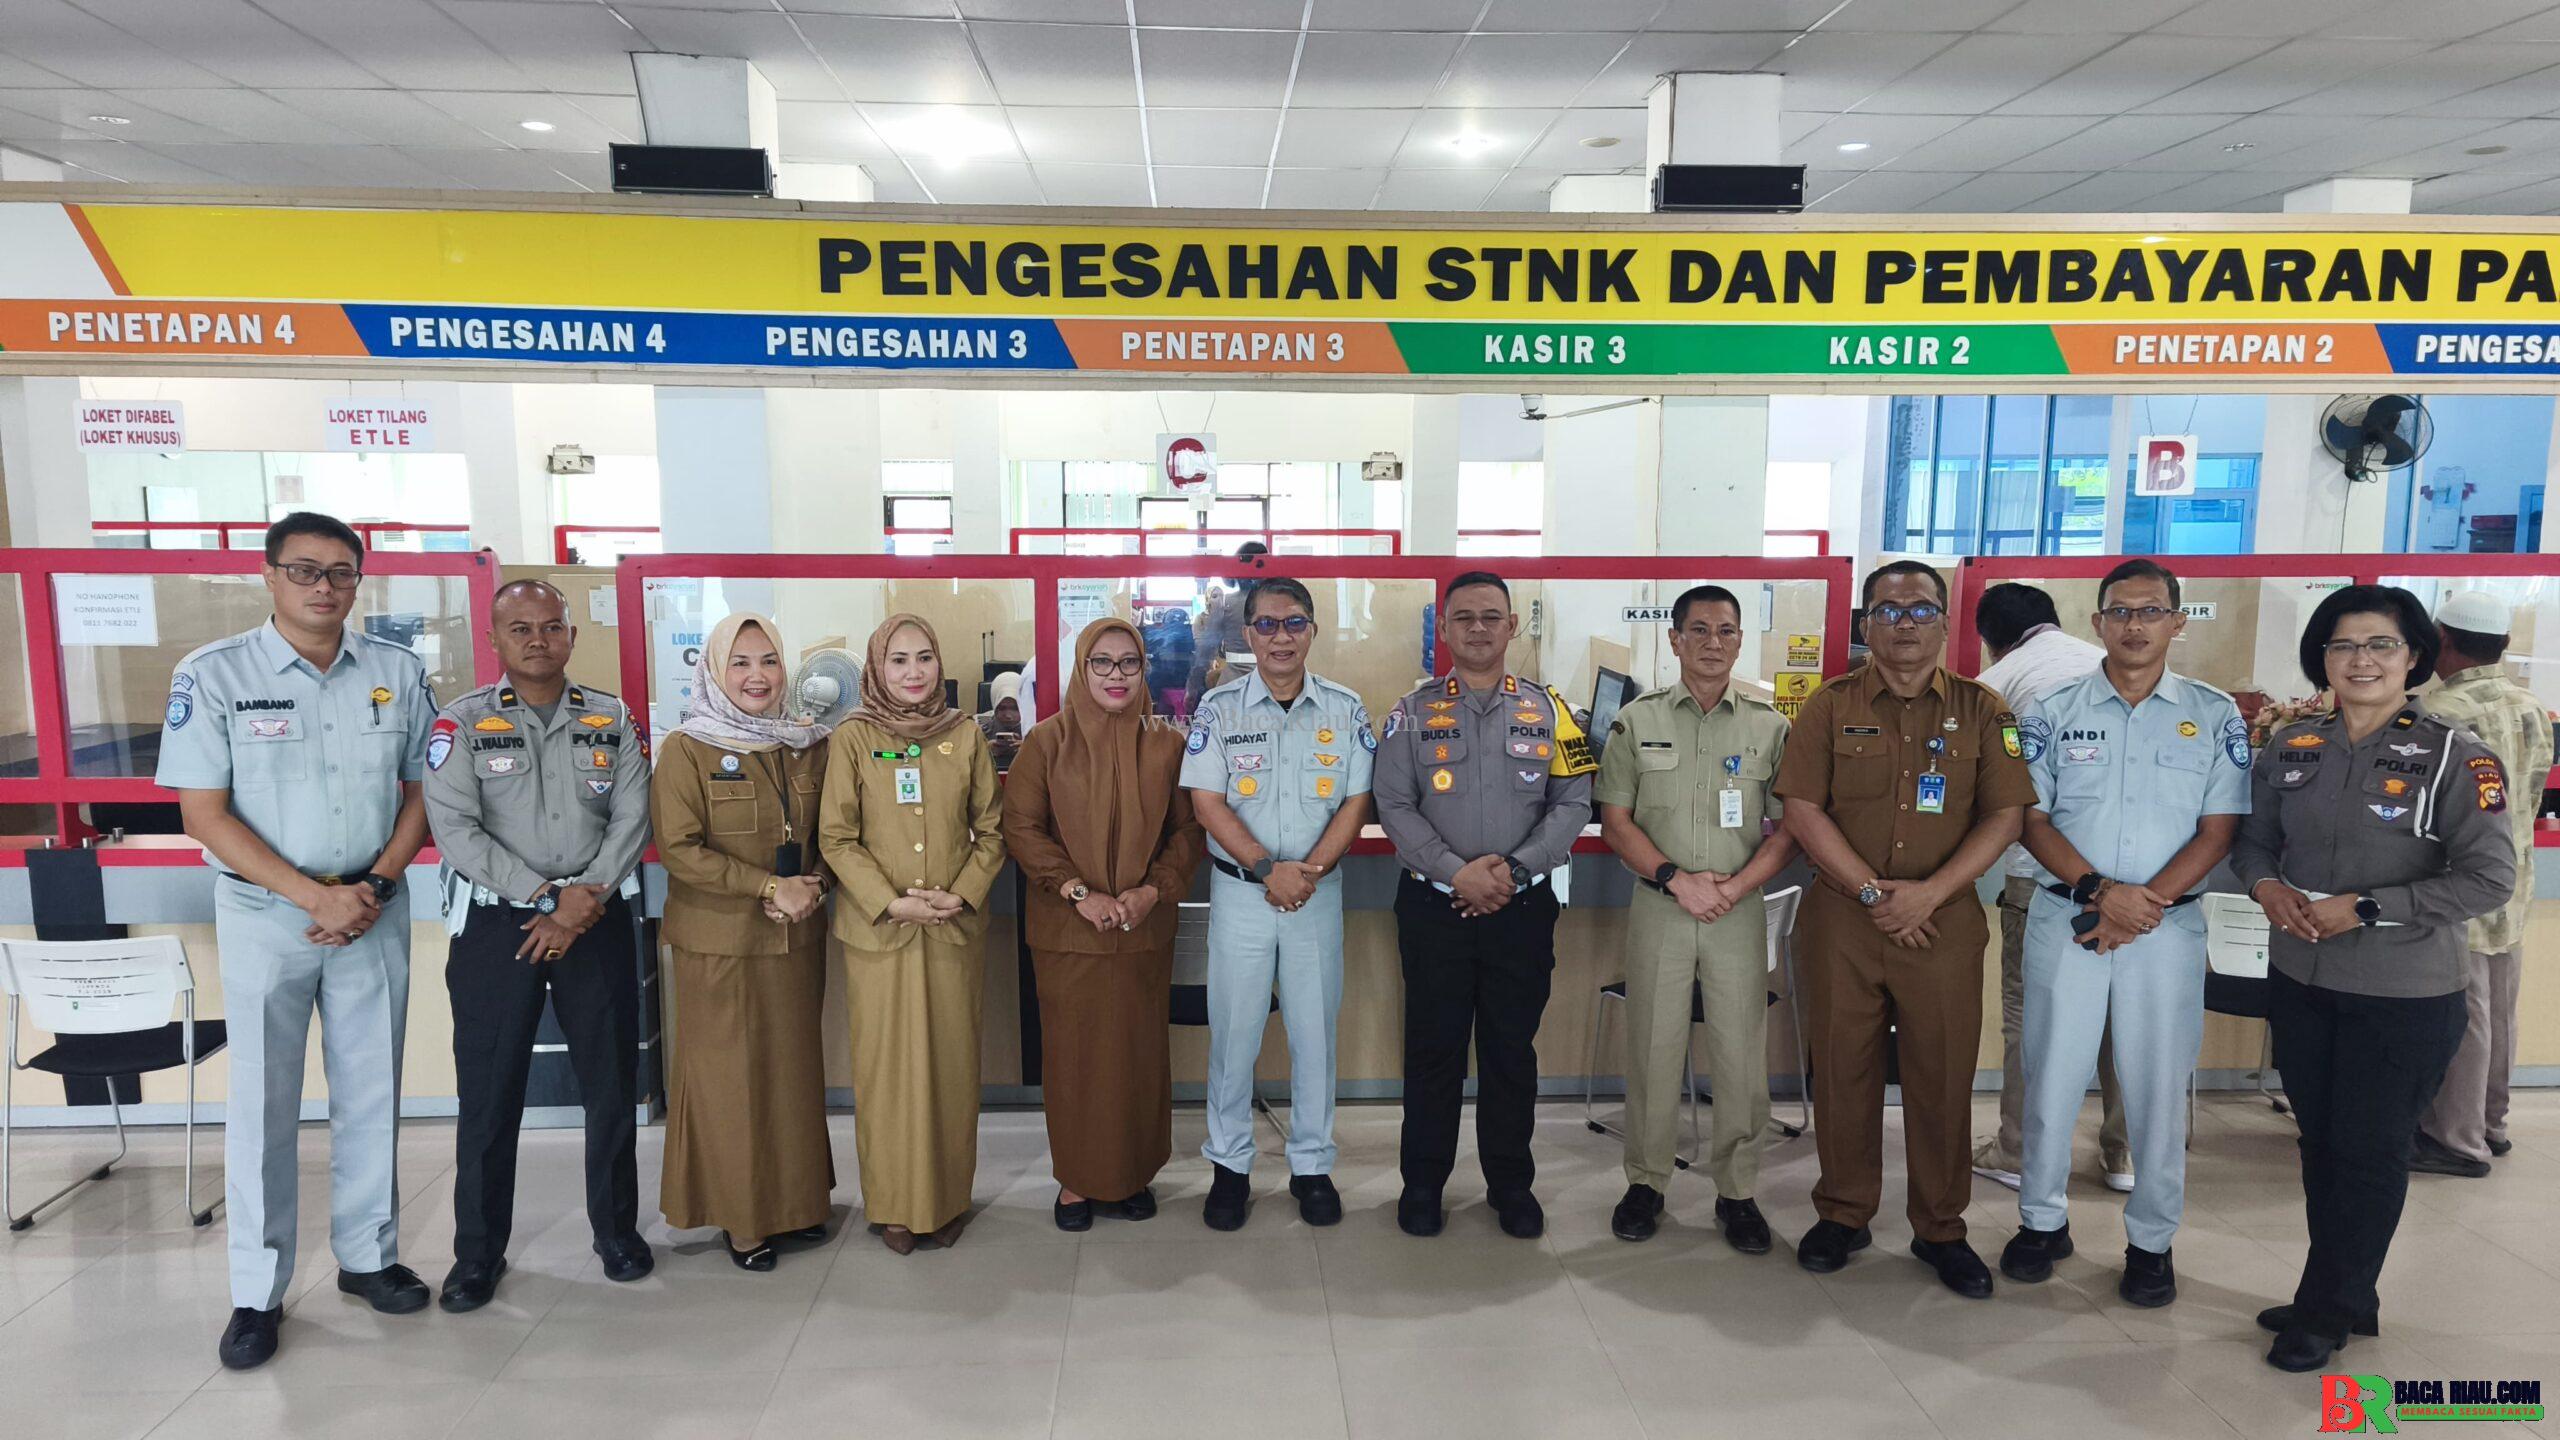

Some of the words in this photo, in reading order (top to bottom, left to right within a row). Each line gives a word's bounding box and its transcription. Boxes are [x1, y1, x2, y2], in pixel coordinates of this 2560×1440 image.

[819, 238, 1397, 301] PENGESAHAN
[1425, 246, 1640, 303] STNK
[1669, 249, 1835, 303] DAN
[1865, 248, 2432, 303] PEMBAYARAN
[2457, 249, 2560, 303] PA
[48, 311, 262, 344] PENETAPAN
[274, 314, 296, 345] 4
[390, 316, 635, 352] PENGESAHAN
[645, 323, 667, 353] 4
[766, 327, 997, 358] PENGESAHAN
[1009, 330, 1028, 359] 3
[1122, 331, 1315, 361] PENETAPAN
[1326, 332, 1345, 361] 3
[1485, 335, 1595, 363] KASIR
[1608, 336, 1627, 364] 3
[1829, 336, 1940, 365] KASIR
[1951, 336, 1971, 365] 2
[2115, 334, 2305, 363] PENETAPAN
[2314, 335, 2334, 363] 2
[82, 409, 121, 424] LOKET
[125, 409, 175, 424] DIFABEL
[328, 409, 373, 424] LOKET
[377, 409, 428, 425] TILANG
[80, 430, 123, 447] (LOKET
[127, 430, 181, 448] KHUSUS)
[349, 430, 410, 446] ETLE
[2145, 440, 2186, 492] B
[672, 632, 703, 646] LOKE
[235, 699, 295, 712] BAMBANG
[1224, 732, 1268, 747] HIDAYAT
[1509, 725, 1551, 739] POLRI
[2061, 730, 2106, 742] ANDI
[2278, 751, 2321, 764] HELEN
[2373, 757, 2428, 777] POLRI
